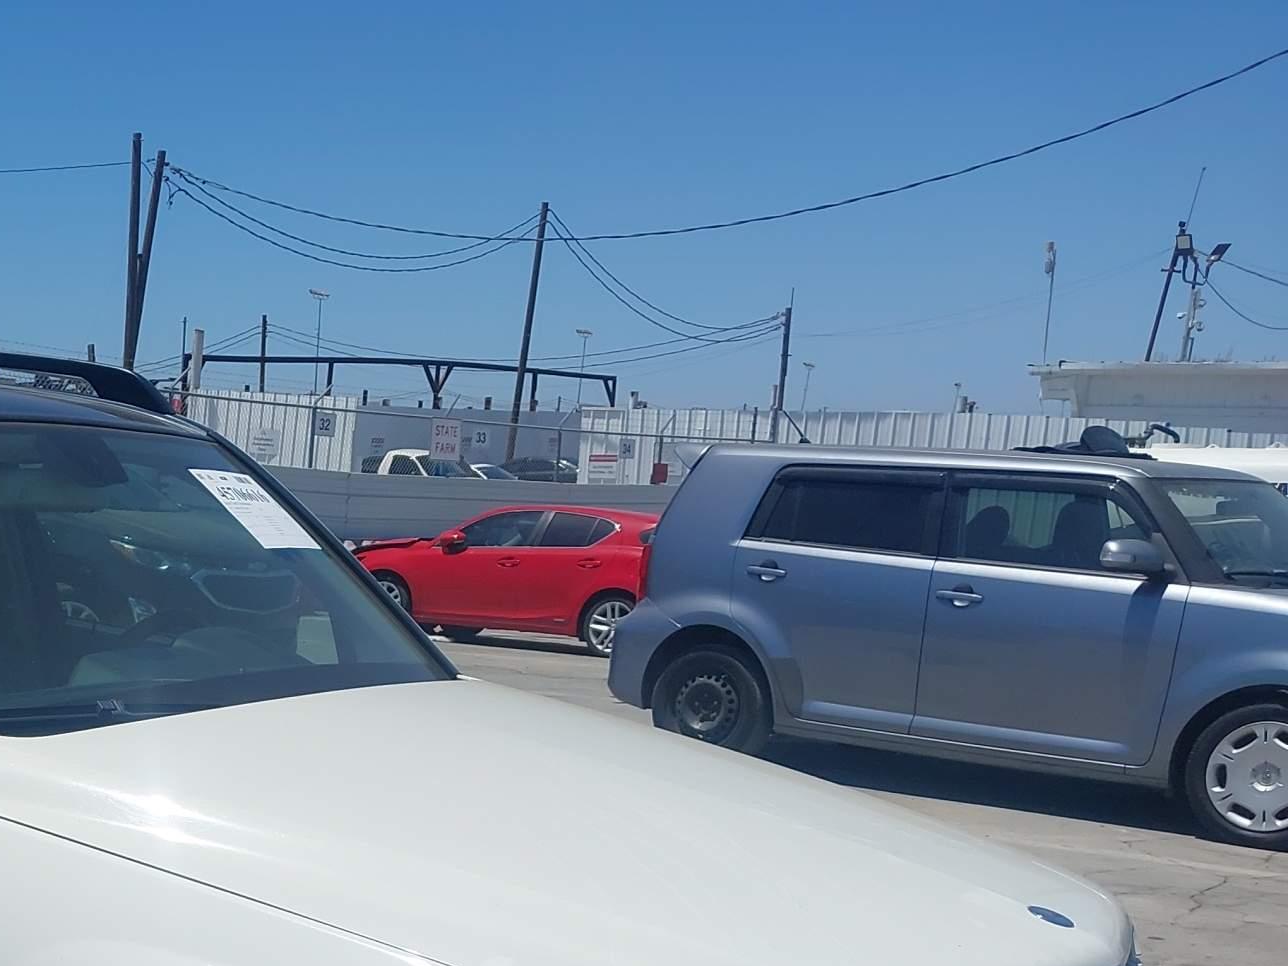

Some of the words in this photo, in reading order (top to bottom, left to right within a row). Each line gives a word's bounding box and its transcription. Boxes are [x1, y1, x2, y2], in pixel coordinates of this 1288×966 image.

[319, 418, 331, 431] 32
[435, 425, 458, 437] STATE
[476, 432, 487, 444] 33
[435, 442, 457, 454] FARM
[622, 443, 631, 454] 34
